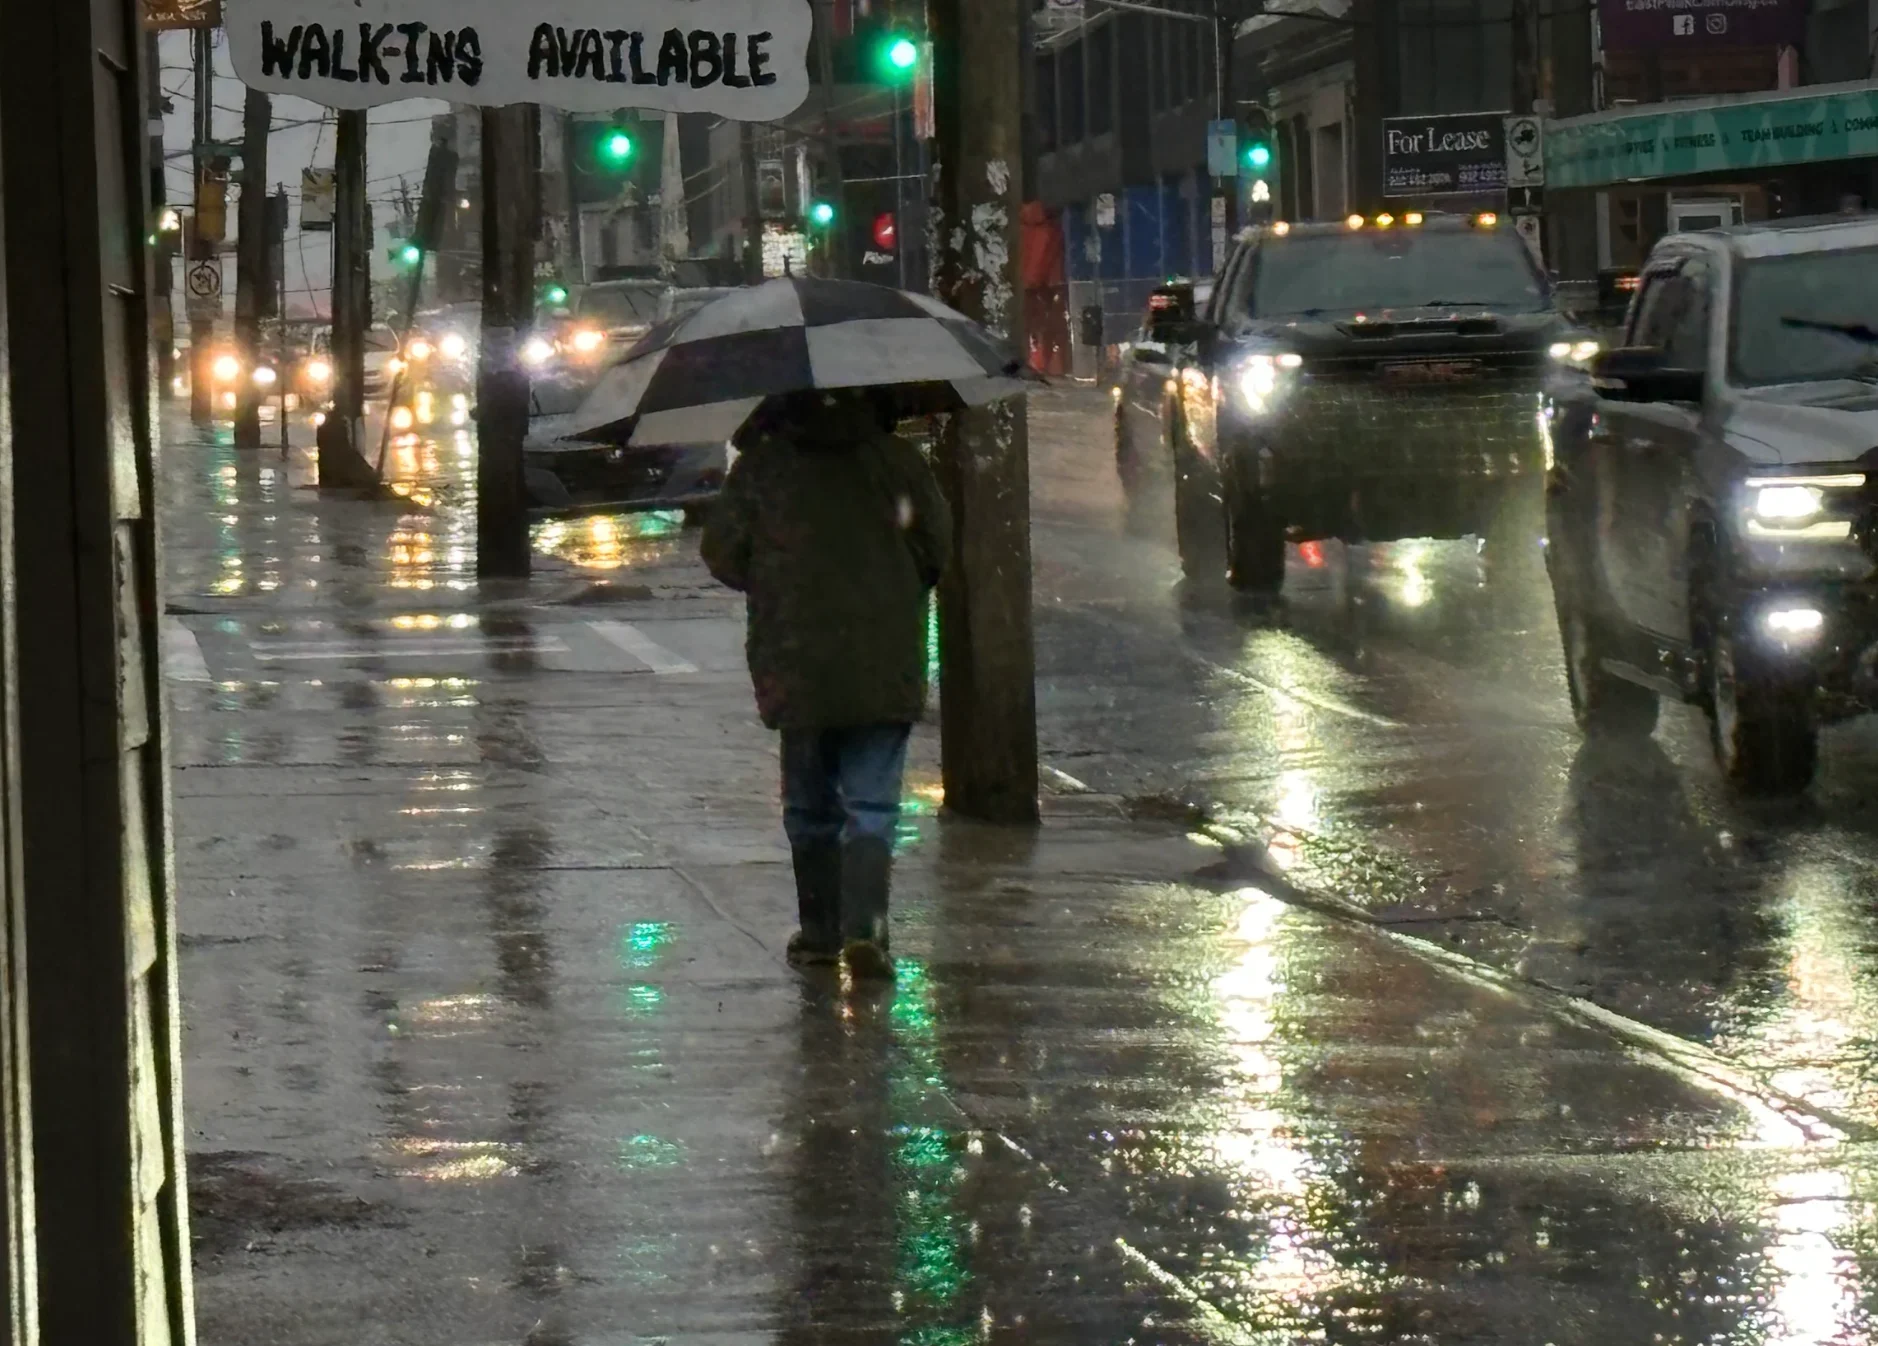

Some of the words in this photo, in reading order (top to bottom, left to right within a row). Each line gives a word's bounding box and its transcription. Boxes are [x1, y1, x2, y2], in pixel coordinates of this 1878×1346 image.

[260, 20, 483, 87] WALK-INS
[527, 22, 778, 88] AVAILABLE
[1387, 129, 1424, 155] For
[1426, 127, 1492, 152] Lease
[1739, 127, 1771, 143] TEAM
[1772, 121, 1824, 140] BUILDING
